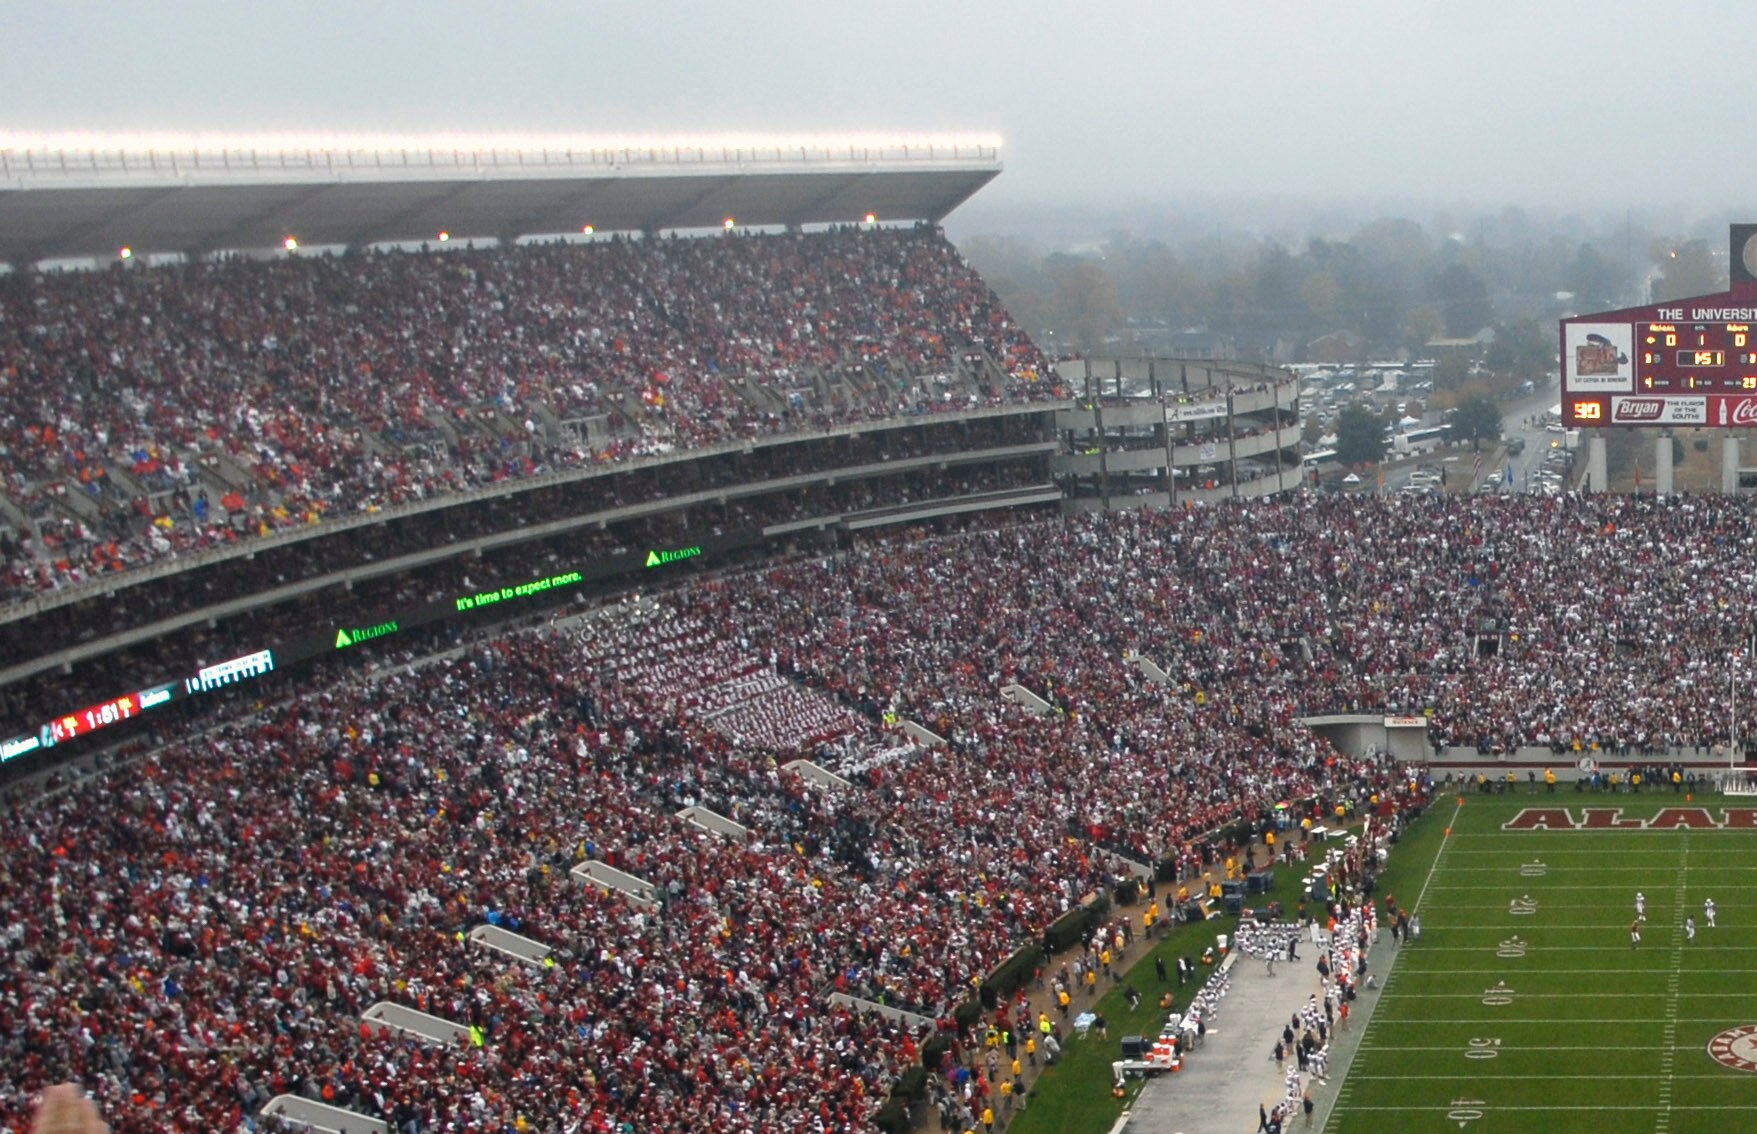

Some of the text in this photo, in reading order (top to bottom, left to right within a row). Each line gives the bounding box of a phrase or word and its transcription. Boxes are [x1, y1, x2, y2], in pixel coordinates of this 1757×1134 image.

[1657, 308, 1683, 320] THE
[1665, 333, 1677, 347] 0
[1734, 333, 1746, 347] 0
[1620, 400, 1660, 417] Bryan
[456, 571, 582, 611] It's time to expect more.
[1508, 899, 1538, 915] 20
[1496, 940, 1528, 958] 30
[1482, 986, 1515, 1006] 40
[1464, 1037, 1502, 1059] 50
[1448, 1097, 1486, 1120] 40
